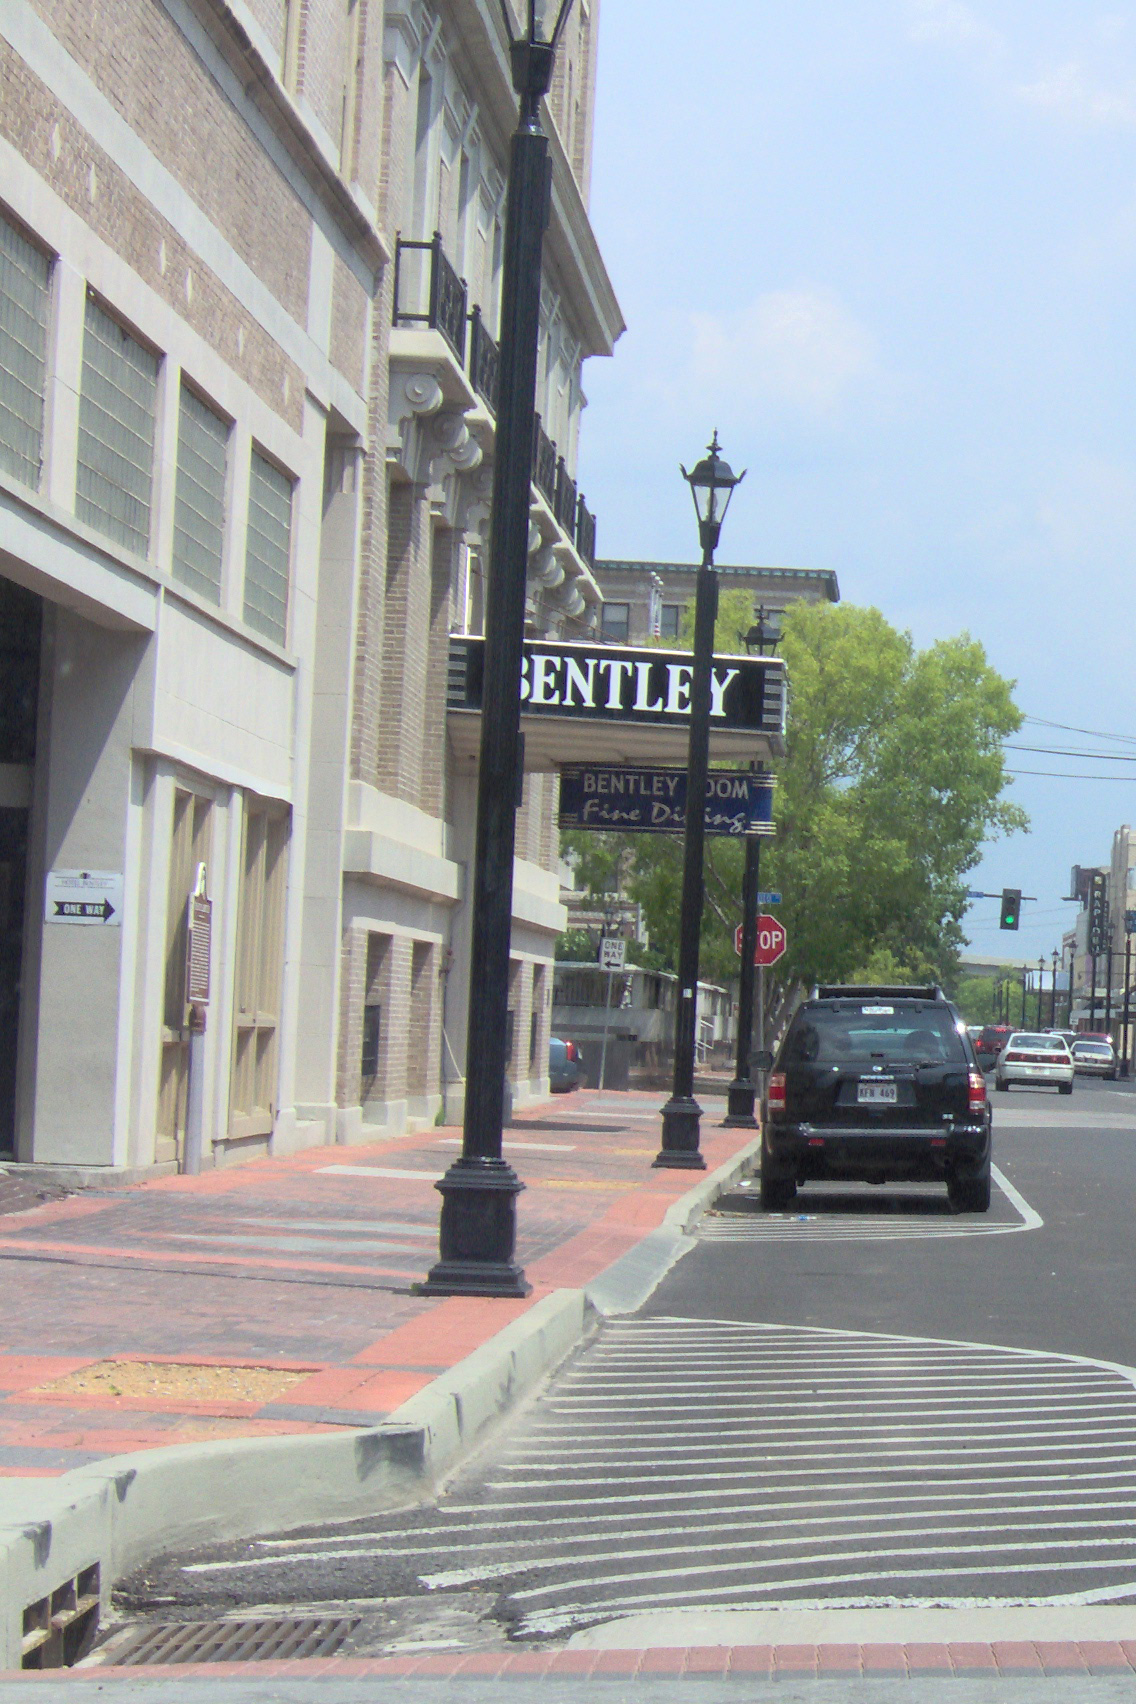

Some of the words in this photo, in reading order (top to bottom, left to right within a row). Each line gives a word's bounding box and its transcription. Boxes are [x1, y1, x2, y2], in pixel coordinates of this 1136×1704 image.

[582, 773, 680, 797] BENTLEY
[705, 778, 750, 801] OOM
[582, 799, 642, 822] Fine
[651, 801, 747, 833] Diing
[64, 903, 82, 914] ONE
[86, 904, 105, 915] WAY
[604, 940, 625, 950] ONE
[604, 951, 624, 959] WAY
